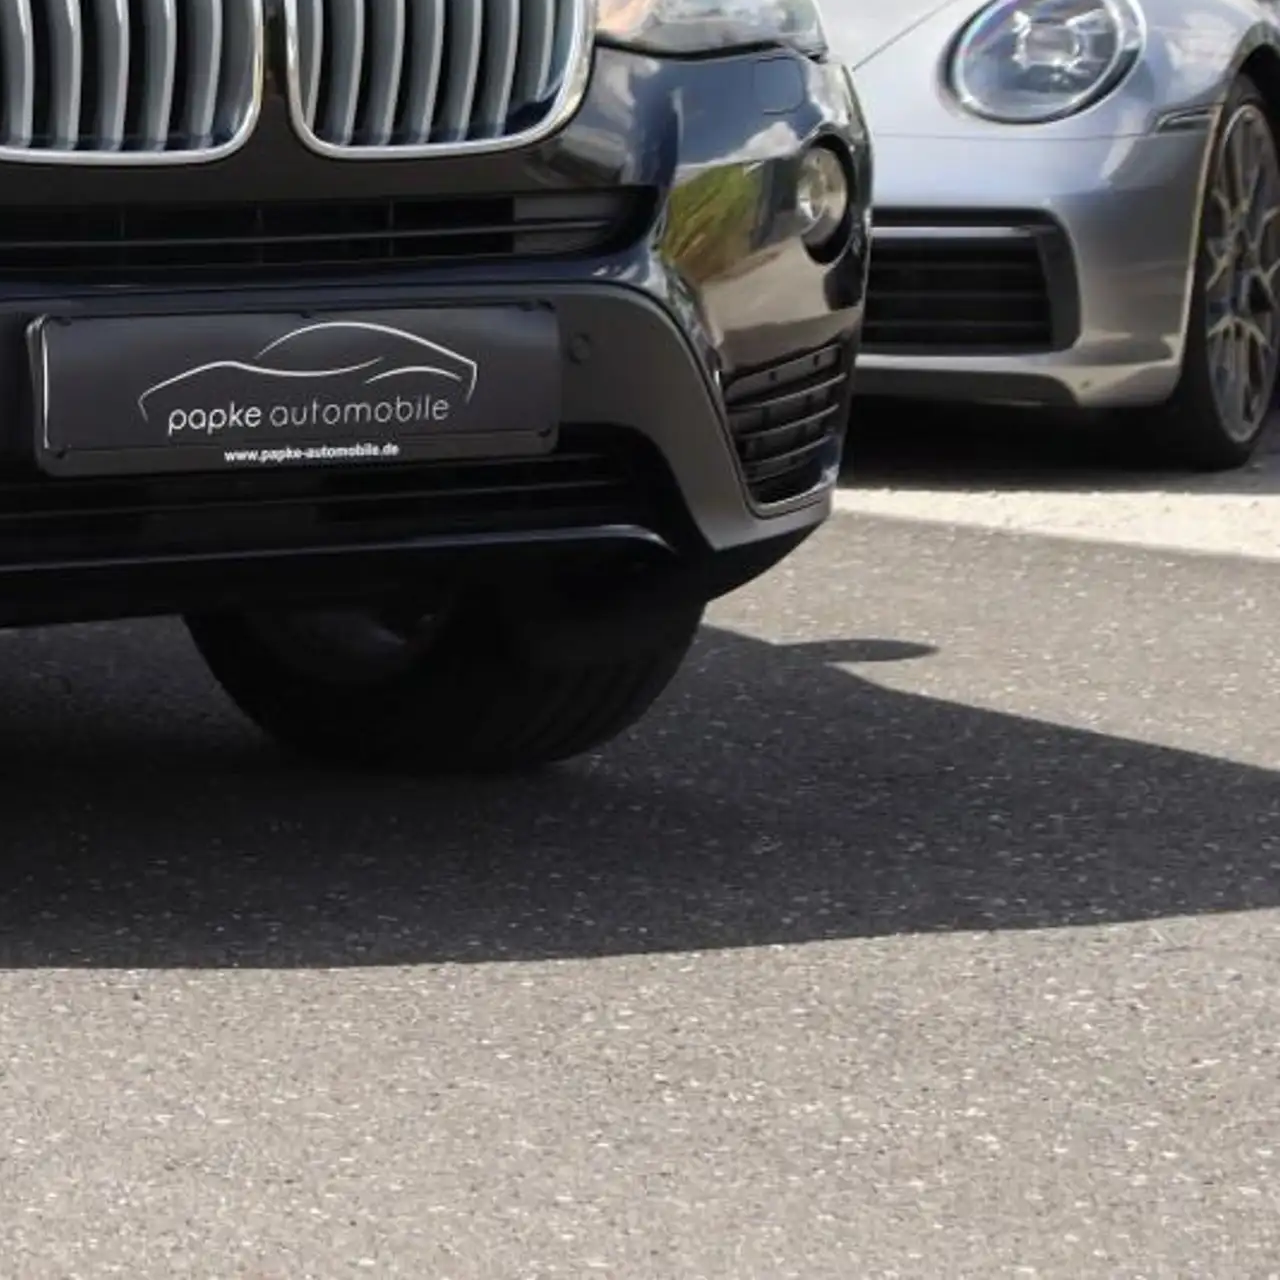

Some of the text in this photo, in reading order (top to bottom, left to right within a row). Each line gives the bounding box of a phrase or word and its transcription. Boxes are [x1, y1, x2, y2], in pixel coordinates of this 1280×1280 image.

[168, 394, 451, 437] papke automobile
[223, 442, 401, 463] www.papke-automobile.de
